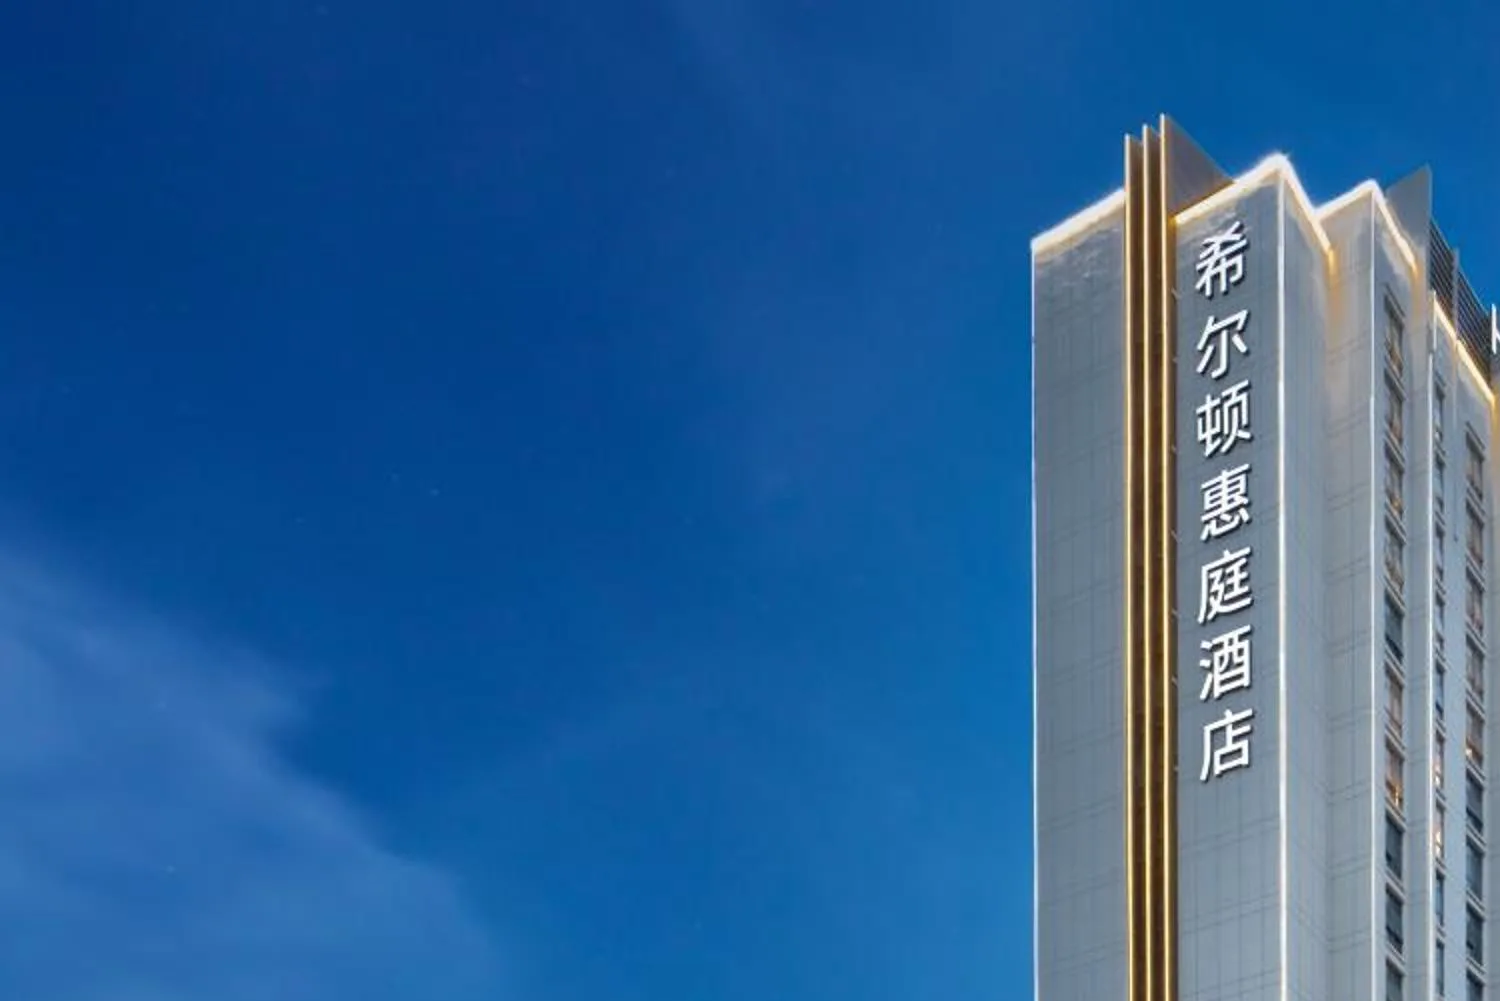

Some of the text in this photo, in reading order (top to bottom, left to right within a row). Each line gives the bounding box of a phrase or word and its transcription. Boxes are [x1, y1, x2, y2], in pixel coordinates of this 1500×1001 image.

[1195, 220, 1254, 783] 希尔顿惠庭酒店
